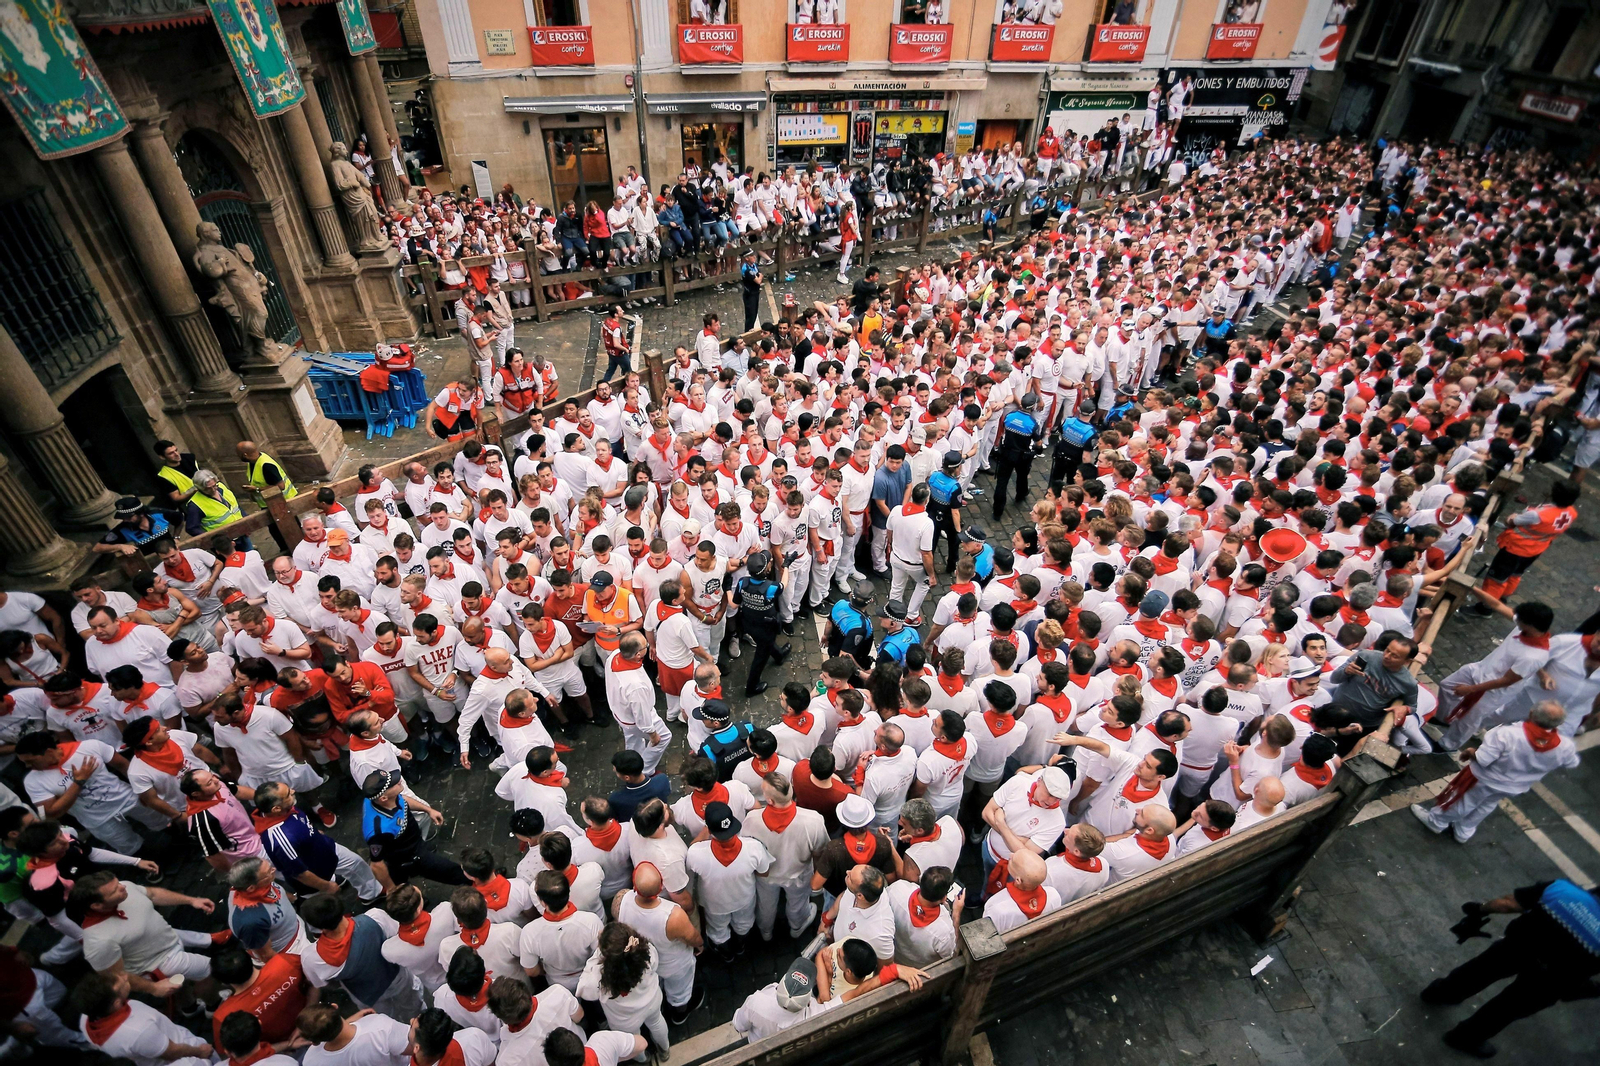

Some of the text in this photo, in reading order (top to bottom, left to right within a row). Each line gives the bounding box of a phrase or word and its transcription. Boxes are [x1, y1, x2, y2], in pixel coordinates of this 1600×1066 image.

[548, 32, 585, 42] EROSKI
[699, 29, 736, 42] EROSKI
[808, 29, 843, 39] EROSKI
[911, 32, 945, 42] EROSKI
[1014, 30, 1047, 40] EROSKI
[1112, 30, 1144, 41] EROSKI
[1227, 28, 1257, 39] EROSKI
[561, 44, 585, 56] contigo
[710, 41, 734, 55] contigo
[817, 43, 841, 52] zurekin
[919, 44, 942, 56] contigo
[1021, 43, 1044, 52] zurekin
[1118, 41, 1139, 54] contigo
[1232, 40, 1252, 51] contigo
[853, 81, 907, 90] ALIMENTACIÓN
[1226, 78, 1235, 89] Y
[1236, 77, 1291, 89] EMBUTIDOS
[1004, 103, 1011, 113] 2
[741, 589, 765, 600] POLICIA
[421, 645, 453, 666] LIKE
[434, 661, 448, 675] IT
[1226, 703, 1246, 712] NMI
[948, 764, 965, 784] 7
[255, 975, 298, 1017] FARROA
[765, 1006, 880, 1063] RESERVED
